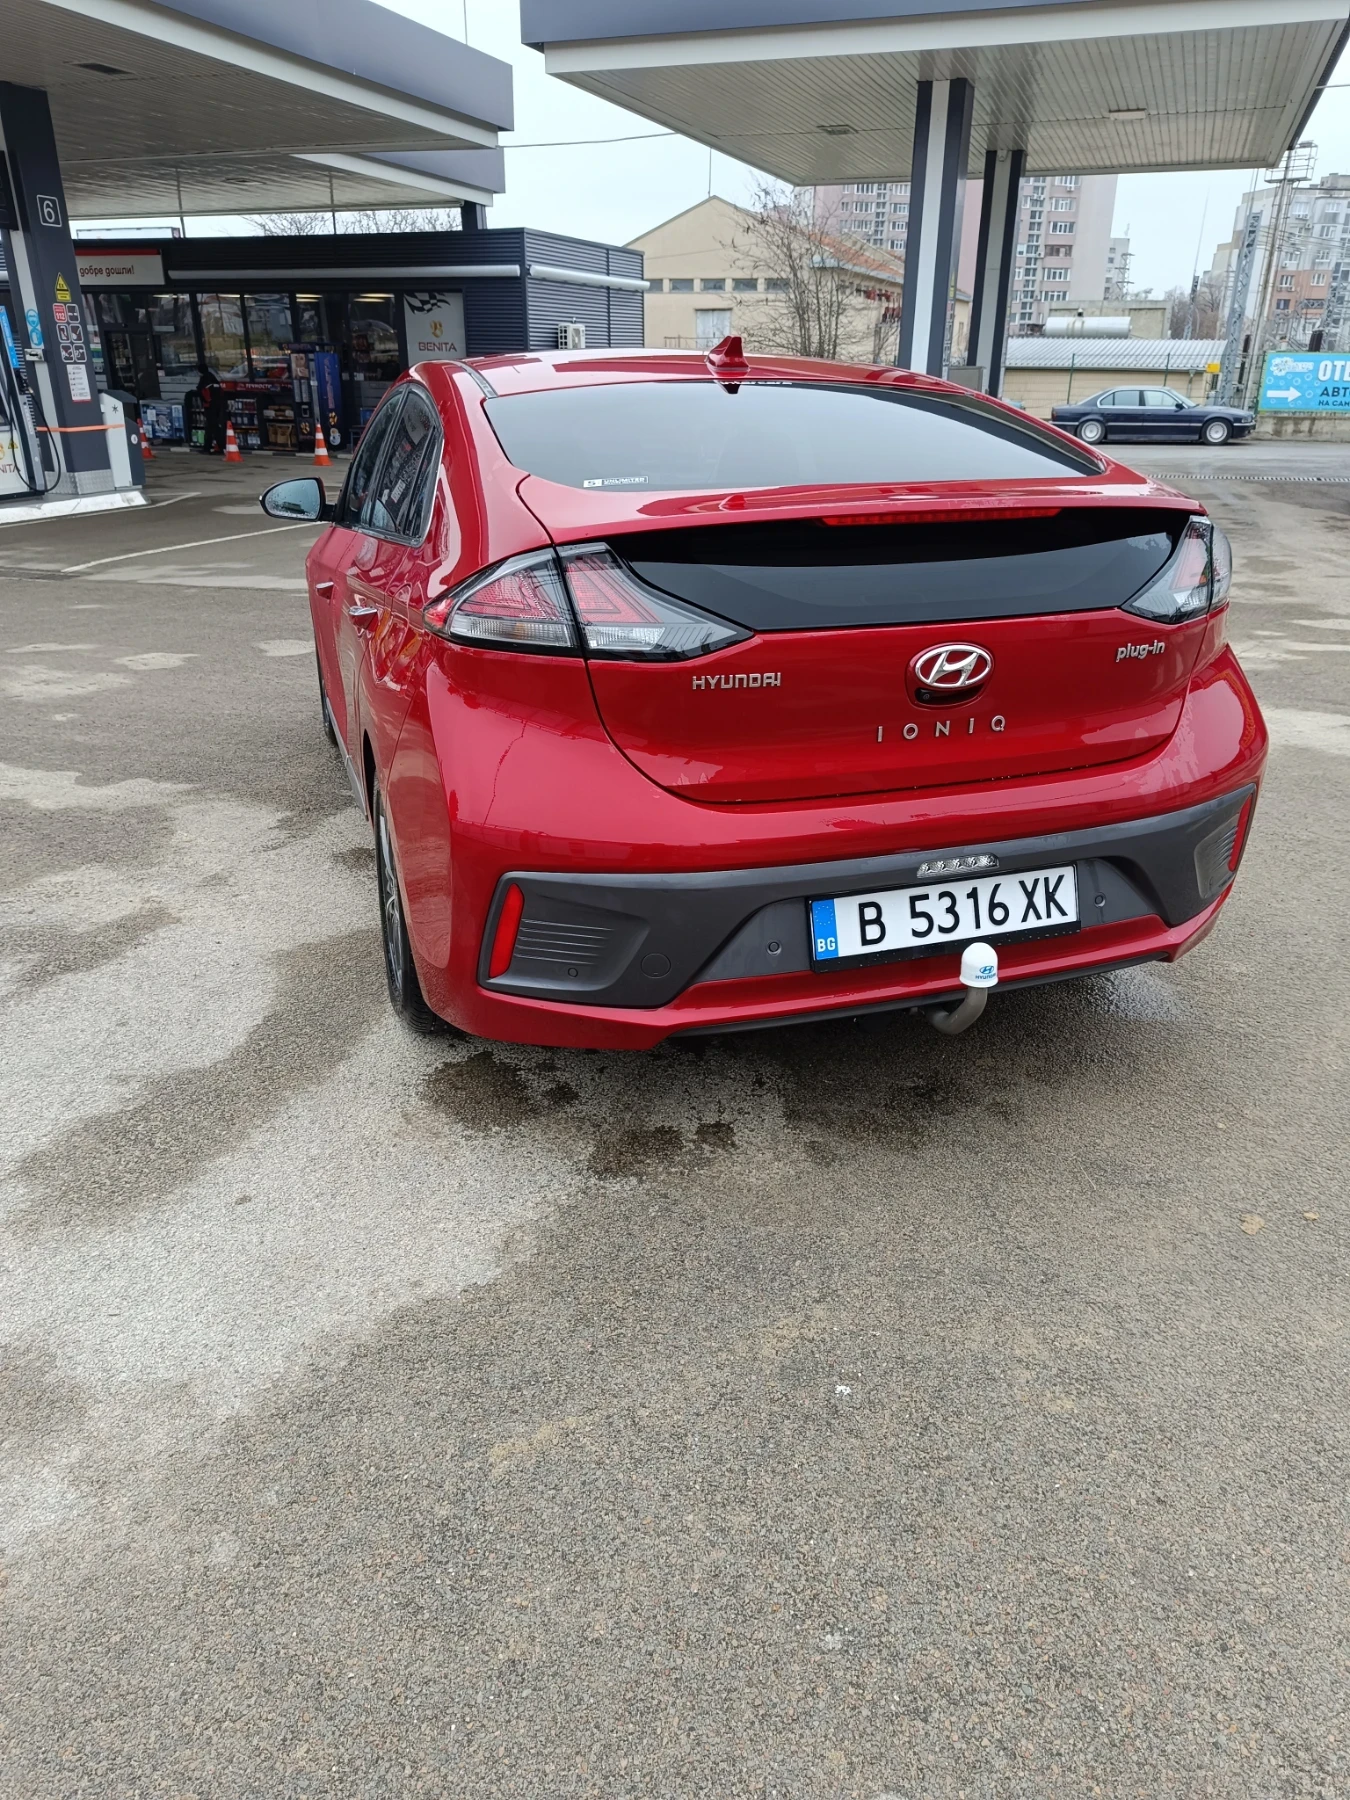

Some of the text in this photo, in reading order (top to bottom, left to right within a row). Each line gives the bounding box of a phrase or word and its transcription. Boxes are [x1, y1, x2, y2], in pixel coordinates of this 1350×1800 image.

[43, 200, 56, 223] 6
[79, 264, 135, 278] добре дошли!
[55, 312, 65, 320] 112
[418, 341, 457, 352] BENITA
[1319, 386, 1350, 397] АВТ
[1115, 639, 1166, 663] plug-in
[692, 672, 781, 690] HYUNDAI
[876, 715, 1006, 743] IONIQ
[858, 874, 1069, 946] B 5316 XK
[817, 937, 837, 953] BG
